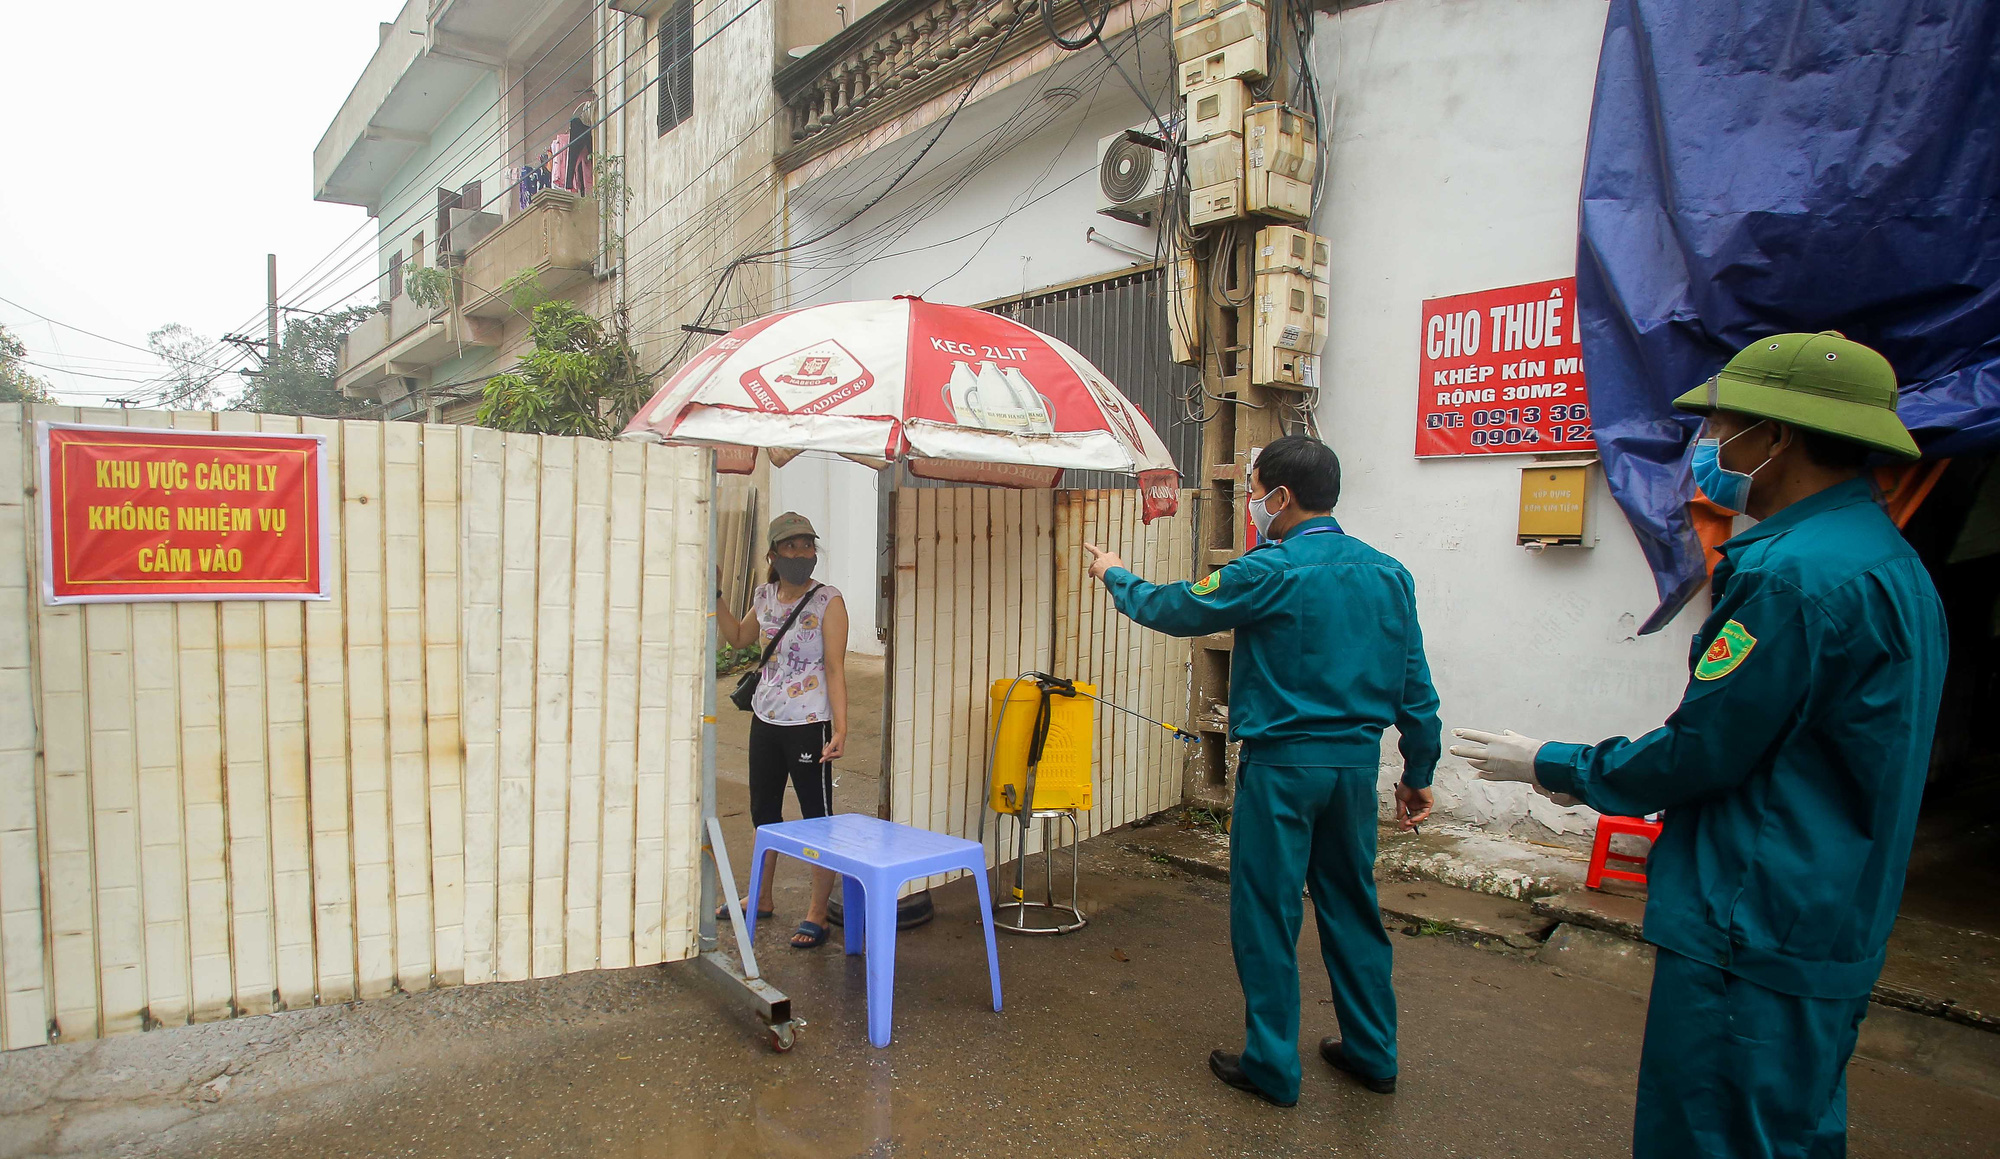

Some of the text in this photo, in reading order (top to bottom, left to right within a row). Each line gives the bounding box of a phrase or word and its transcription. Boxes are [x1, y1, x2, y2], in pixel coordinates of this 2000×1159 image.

[1426, 309, 1481, 360] CHO
[1490, 287, 1564, 353] THUÊ
[930, 336, 1027, 361] KEG 2LIT
[1433, 365, 1494, 386] KHÉP
[1502, 359, 1546, 381] KÍN
[803, 379, 868, 413] RADING 89
[1437, 387, 1496, 407] RỘNG
[1502, 382, 1567, 401] 30M2
[1426, 403, 1589, 430] ĐT: 0913 36
[1471, 427, 1539, 446] 0904
[96, 457, 277, 495] KHU VỰC CÁCH LY
[88, 501, 286, 537] KHÔNG NHIỆM VỤ
[138, 540, 242, 572] CẤM VÀO
